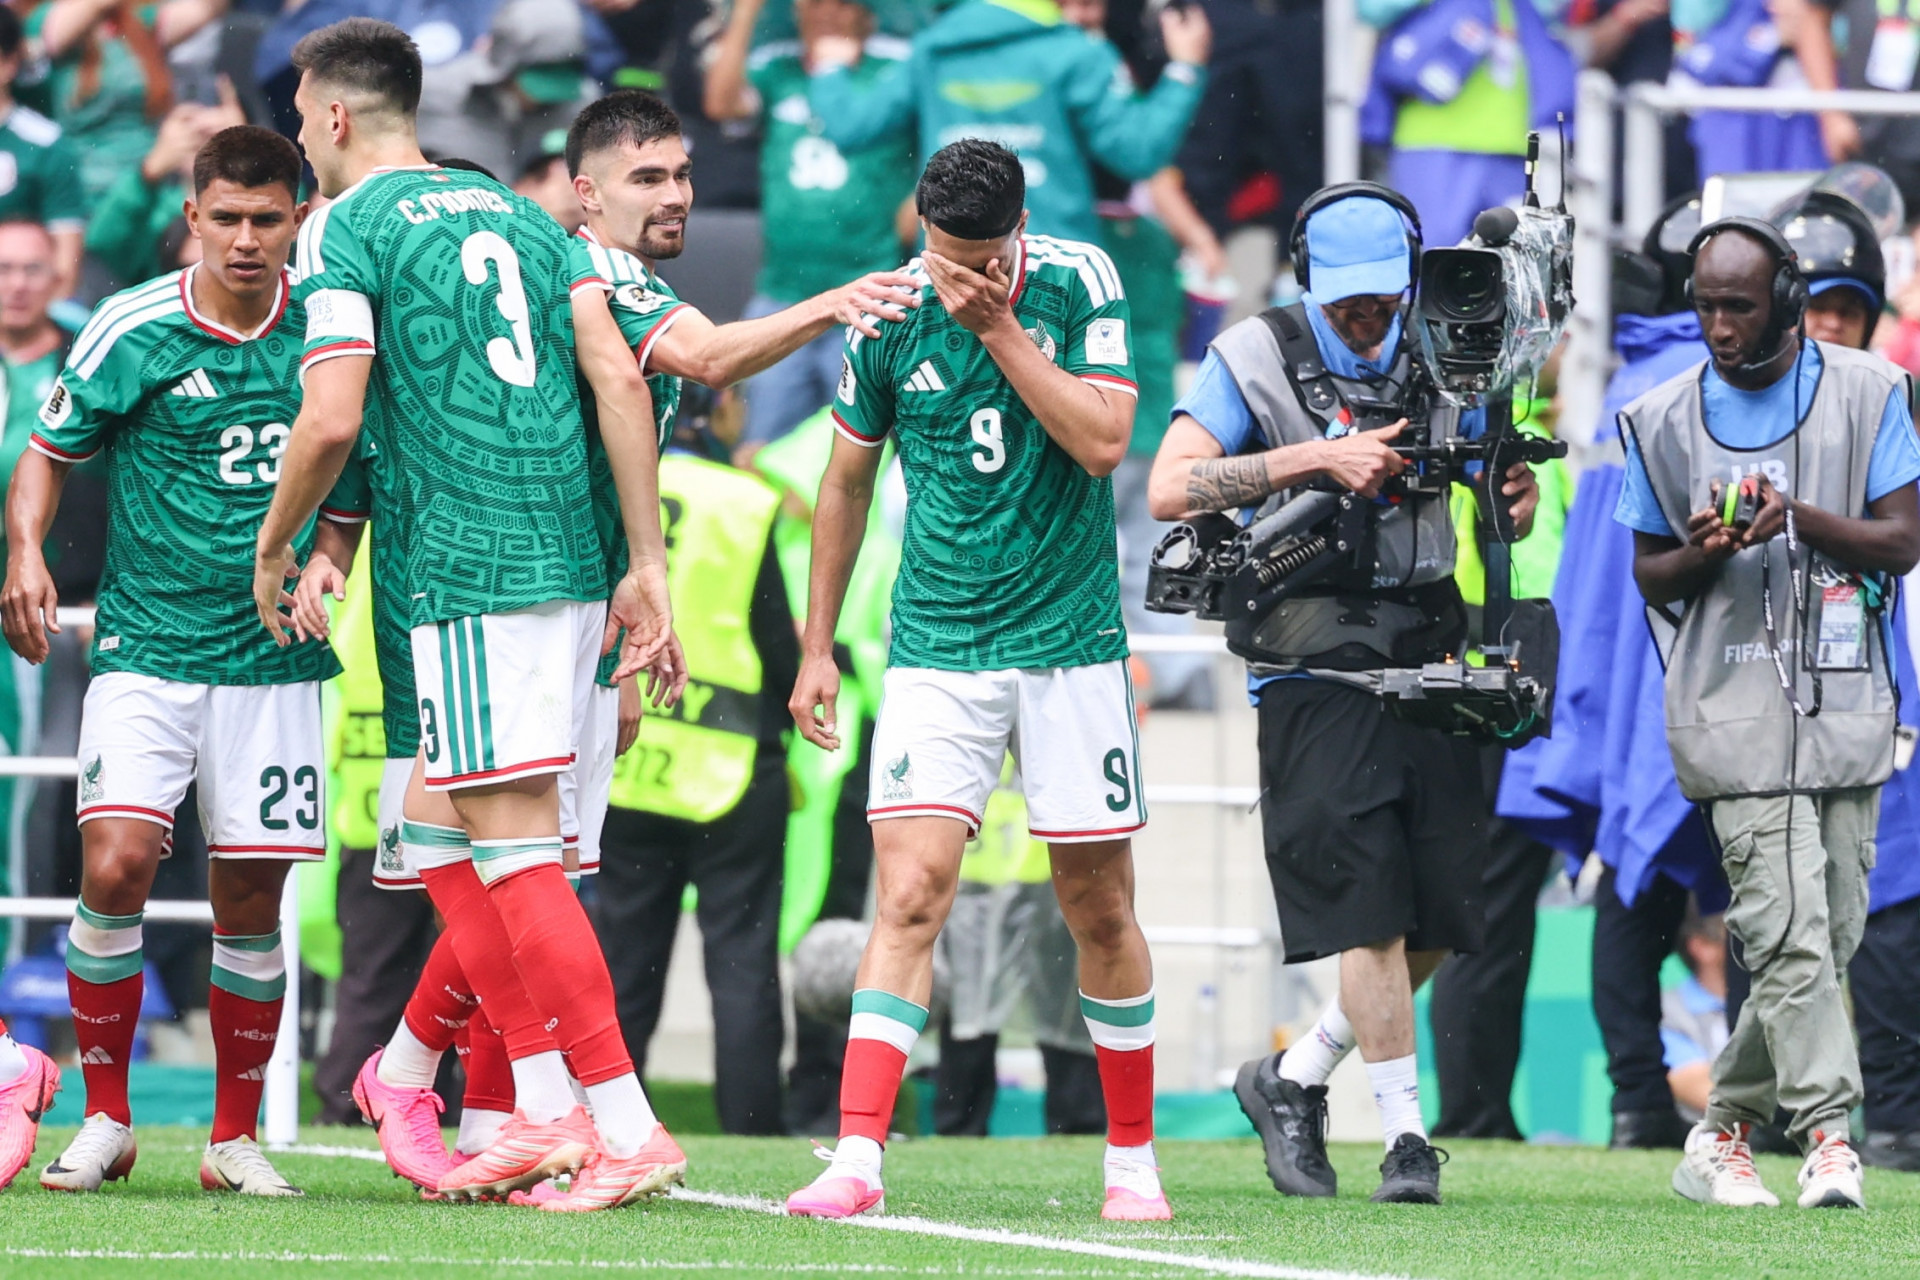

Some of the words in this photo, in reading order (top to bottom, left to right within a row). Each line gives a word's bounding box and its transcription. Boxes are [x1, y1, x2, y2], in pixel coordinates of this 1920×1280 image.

[460, 230, 536, 387] 3
[219, 422, 291, 485] 23
[969, 407, 1006, 473] 9
[421, 697, 441, 764] 3
[260, 764, 319, 830] 23
